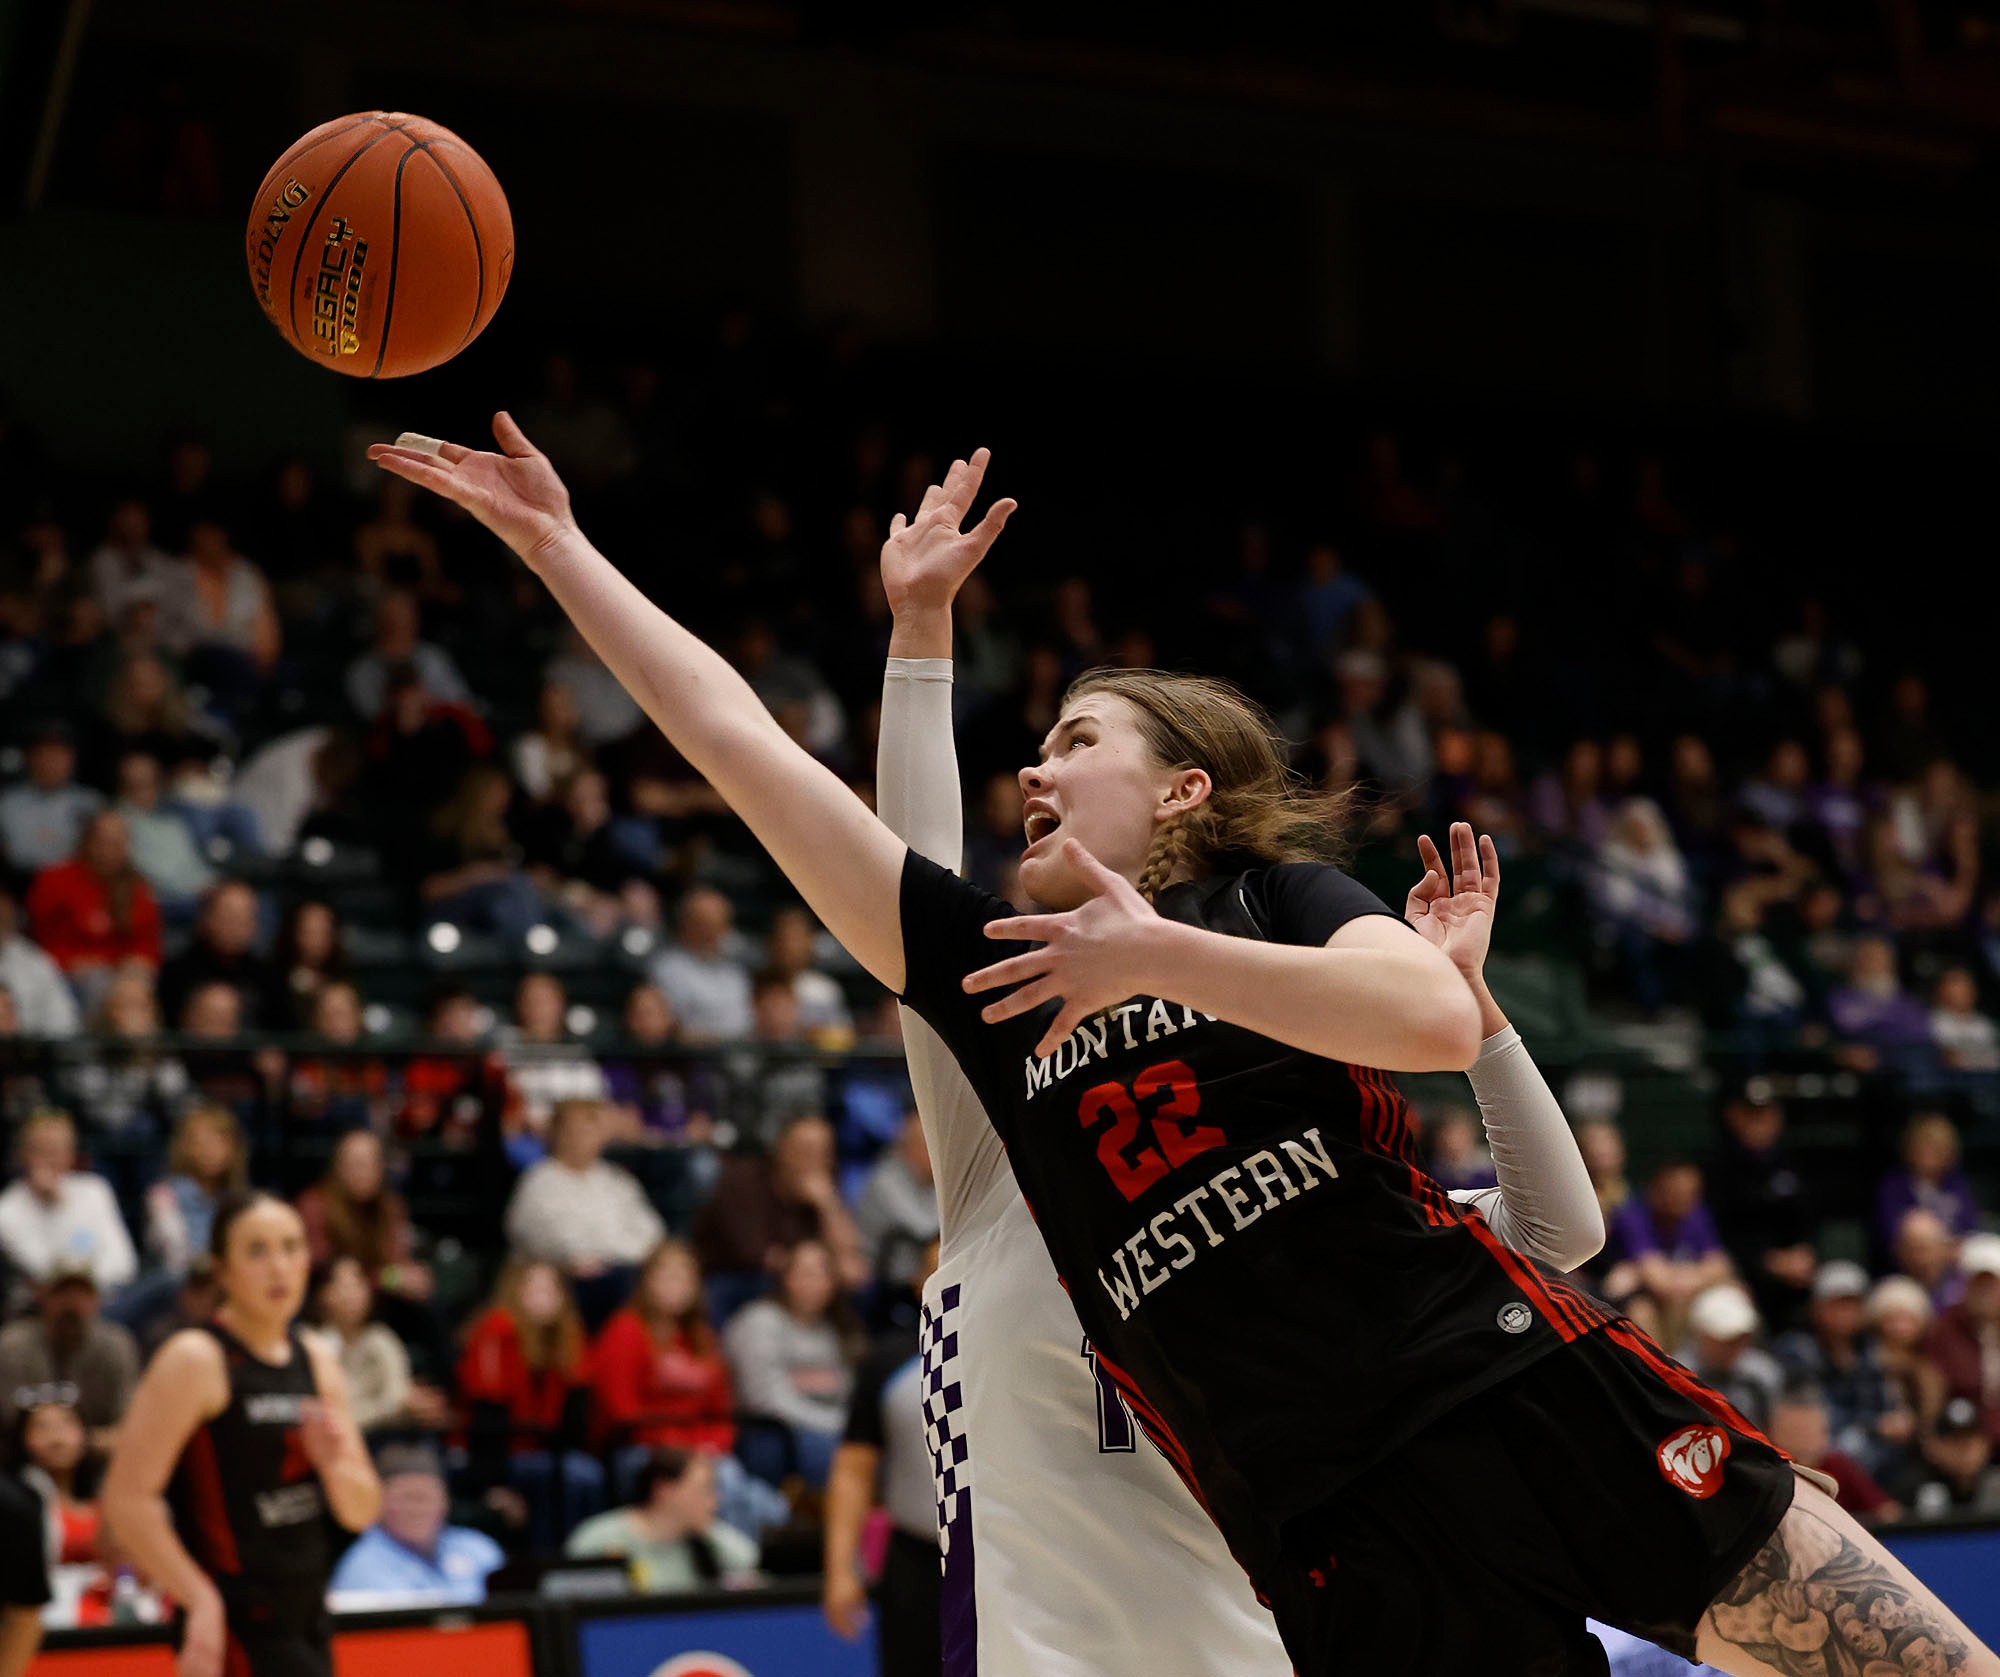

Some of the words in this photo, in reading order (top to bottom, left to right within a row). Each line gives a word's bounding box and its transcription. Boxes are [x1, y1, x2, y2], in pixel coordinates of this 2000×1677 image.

[256, 176, 312, 306] ALDING
[312, 216, 353, 356] LEGACY
[1077, 1059, 1228, 1203] 22
[1097, 1127, 1340, 1322] WESTERN
